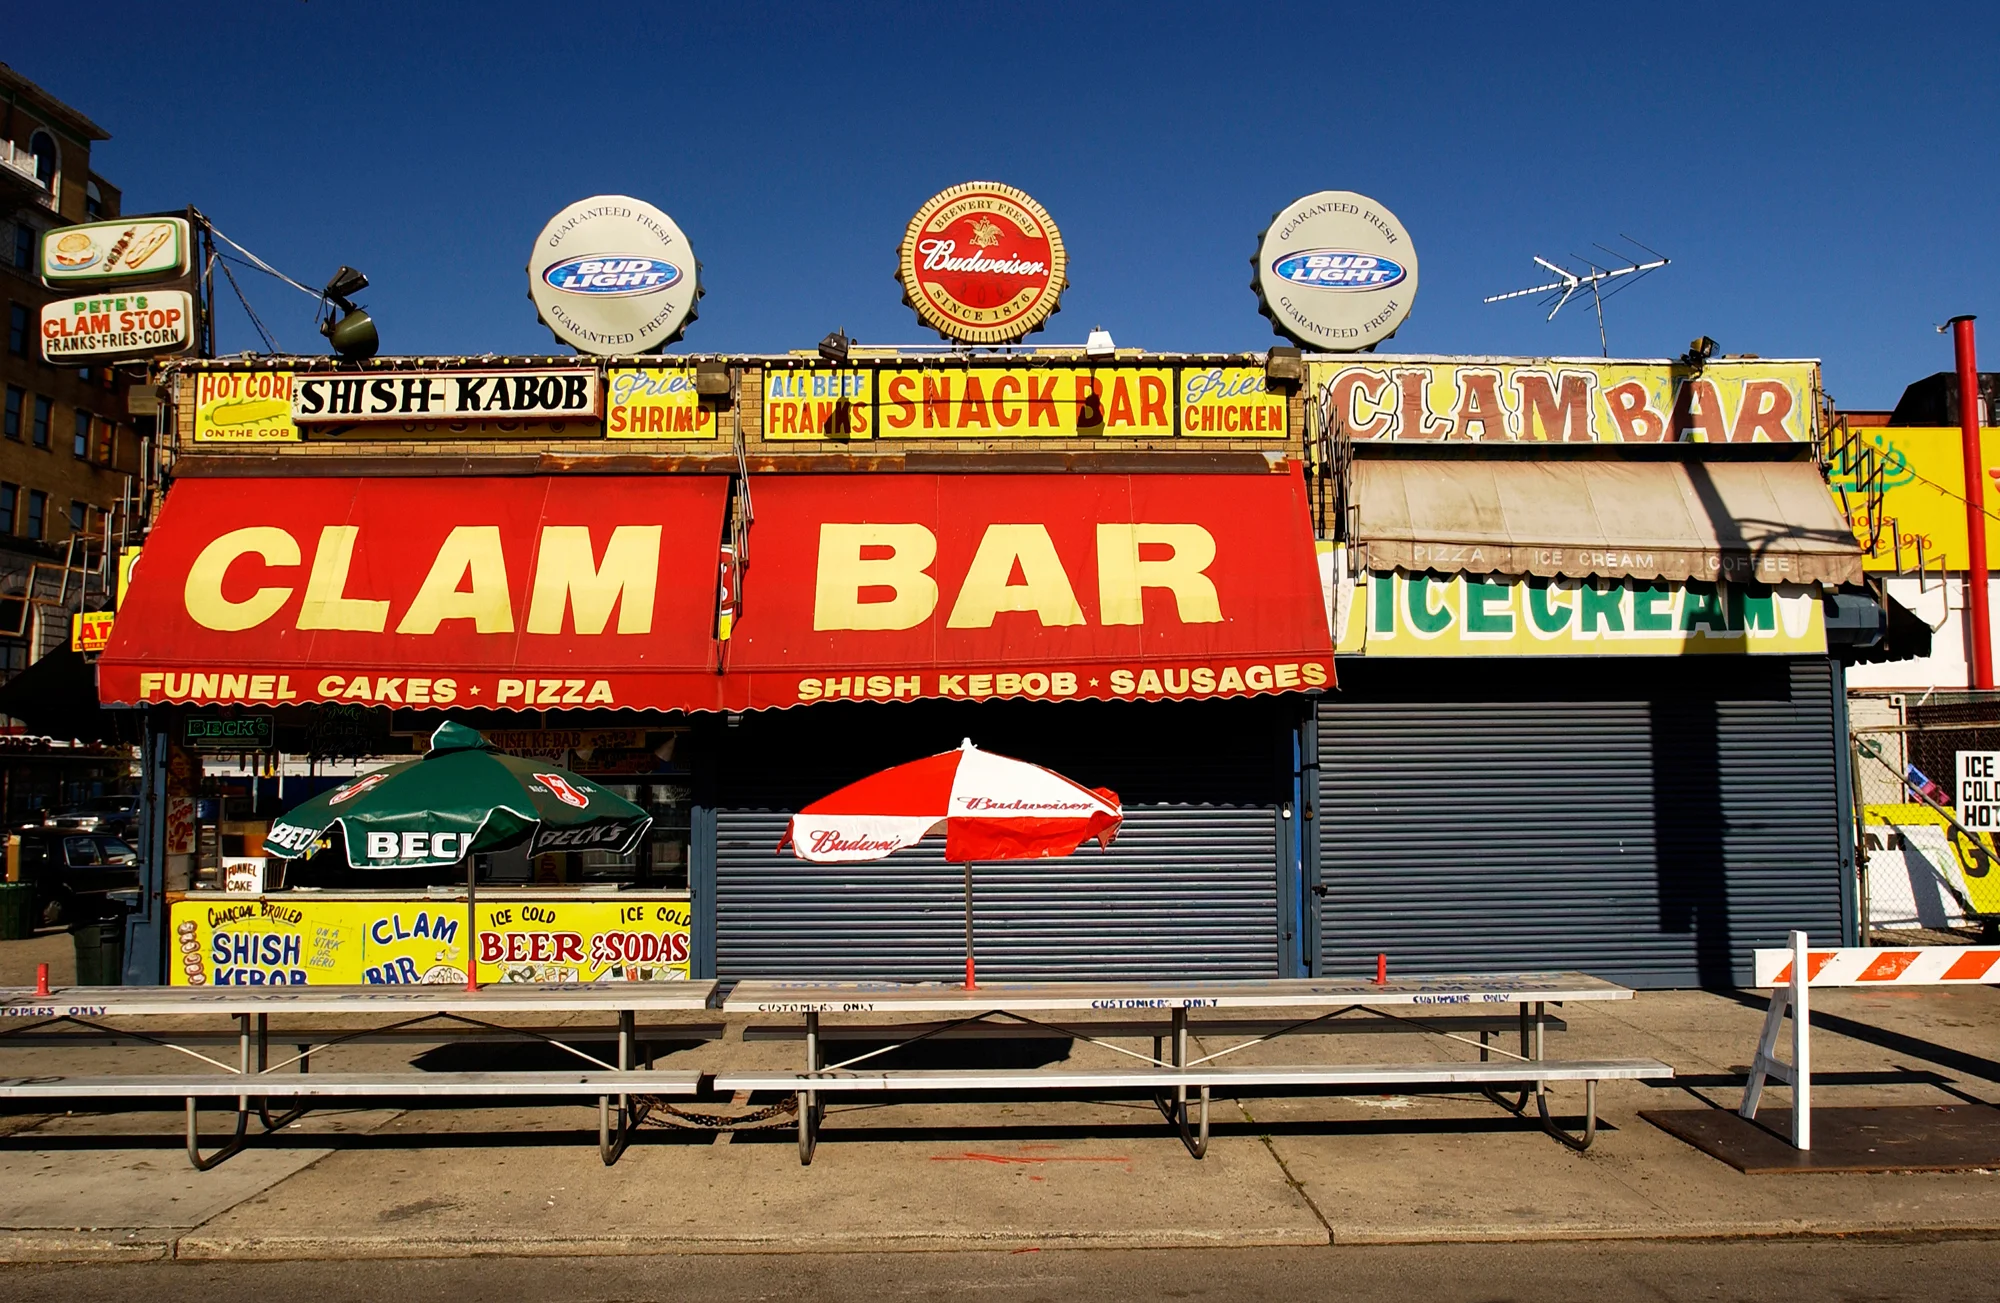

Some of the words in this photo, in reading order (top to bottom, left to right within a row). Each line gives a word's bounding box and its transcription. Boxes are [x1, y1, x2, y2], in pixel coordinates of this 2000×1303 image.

[549, 206, 631, 248] GUARANTEED
[636, 213, 673, 246] FRESH
[934, 200, 994, 229] BREWERY
[998, 203, 1035, 234] FRESH
[1280, 202, 1359, 241] GUARANTEED
[1363, 210, 1398, 244] FRESH
[577, 260, 653, 275] BUD
[918, 239, 1050, 276] Budweiser
[1305, 256, 1378, 269] BUD
[562, 272, 666, 288] LIGHT
[1291, 268, 1390, 283] LIGHT
[74, 296, 148, 315] PETE'S
[933, 289, 983, 321] SINCE
[993, 293, 1030, 320] 1876
[1280, 296, 1359, 338] GUARANTEED
[1364, 300, 1399, 333] FRESH
[43, 312, 111, 338] CLAM
[121, 308, 181, 333] STOP
[551, 304, 634, 345] GUARANTEED
[639, 302, 675, 338] FRESH
[202, 375, 241, 405] HOT
[769, 375, 808, 399] ALL
[813, 375, 865, 398] BEEF
[887, 375, 1060, 429] SNACK
[1076, 374, 1168, 428] BAR
[1329, 369, 1597, 442] CLAM
[1604, 378, 1798, 442] BAR
[610, 405, 710, 433] SHRIMP
[769, 402, 868, 434] FRANKS
[1185, 405, 1282, 432] CHICKEN
[205, 429, 225, 437] ON
[228, 429, 253, 438] THE
[259, 429, 289, 437] COB
[1413, 545, 1486, 563] PIZZA
[1534, 550, 1563, 567] ICE
[1579, 551, 1654, 569] CREAM
[1709, 553, 1790, 573] COFFEE
[183, 525, 663, 635] CLAM
[813, 522, 1225, 631] BAR
[140, 672, 297, 701] FUNNEL
[317, 675, 458, 704] CAKES
[497, 679, 614, 704] PIZZA
[798, 674, 921, 701] SHISH
[938, 671, 1079, 697] KEBOB
[1109, 663, 1328, 696] SAUSAGES
[187, 717, 269, 737] BECK'S
[1965, 756, 1994, 778] ICE
[957, 796, 1095, 812] Budweiser
[1963, 781, 2000, 802] COLD
[1964, 805, 2000, 826] HOT
[538, 823, 628, 848] BECK'S
[810, 830, 904, 853] Budwei
[227, 863, 257, 880] FUNNEL
[227, 880, 253, 892] CAKE
[208, 904, 256, 928] CHARCOAL
[260, 902, 303, 925] BROILED
[491, 909, 513, 927] ICE
[522, 906, 556, 924] COLD
[621, 906, 644, 924] ICE
[657, 907, 691, 927] COLD
[316, 927, 330, 937] ON
[331, 929, 340, 939] A
[371, 912, 459, 945] CLAM
[212, 933, 301, 966] SHISH
[317, 949, 331, 958] OR
[478, 932, 585, 963] BEER
[309, 956, 336, 968] HERO
[365, 956, 421, 985] BAR
[69, 1006, 107, 1016] ONLY
